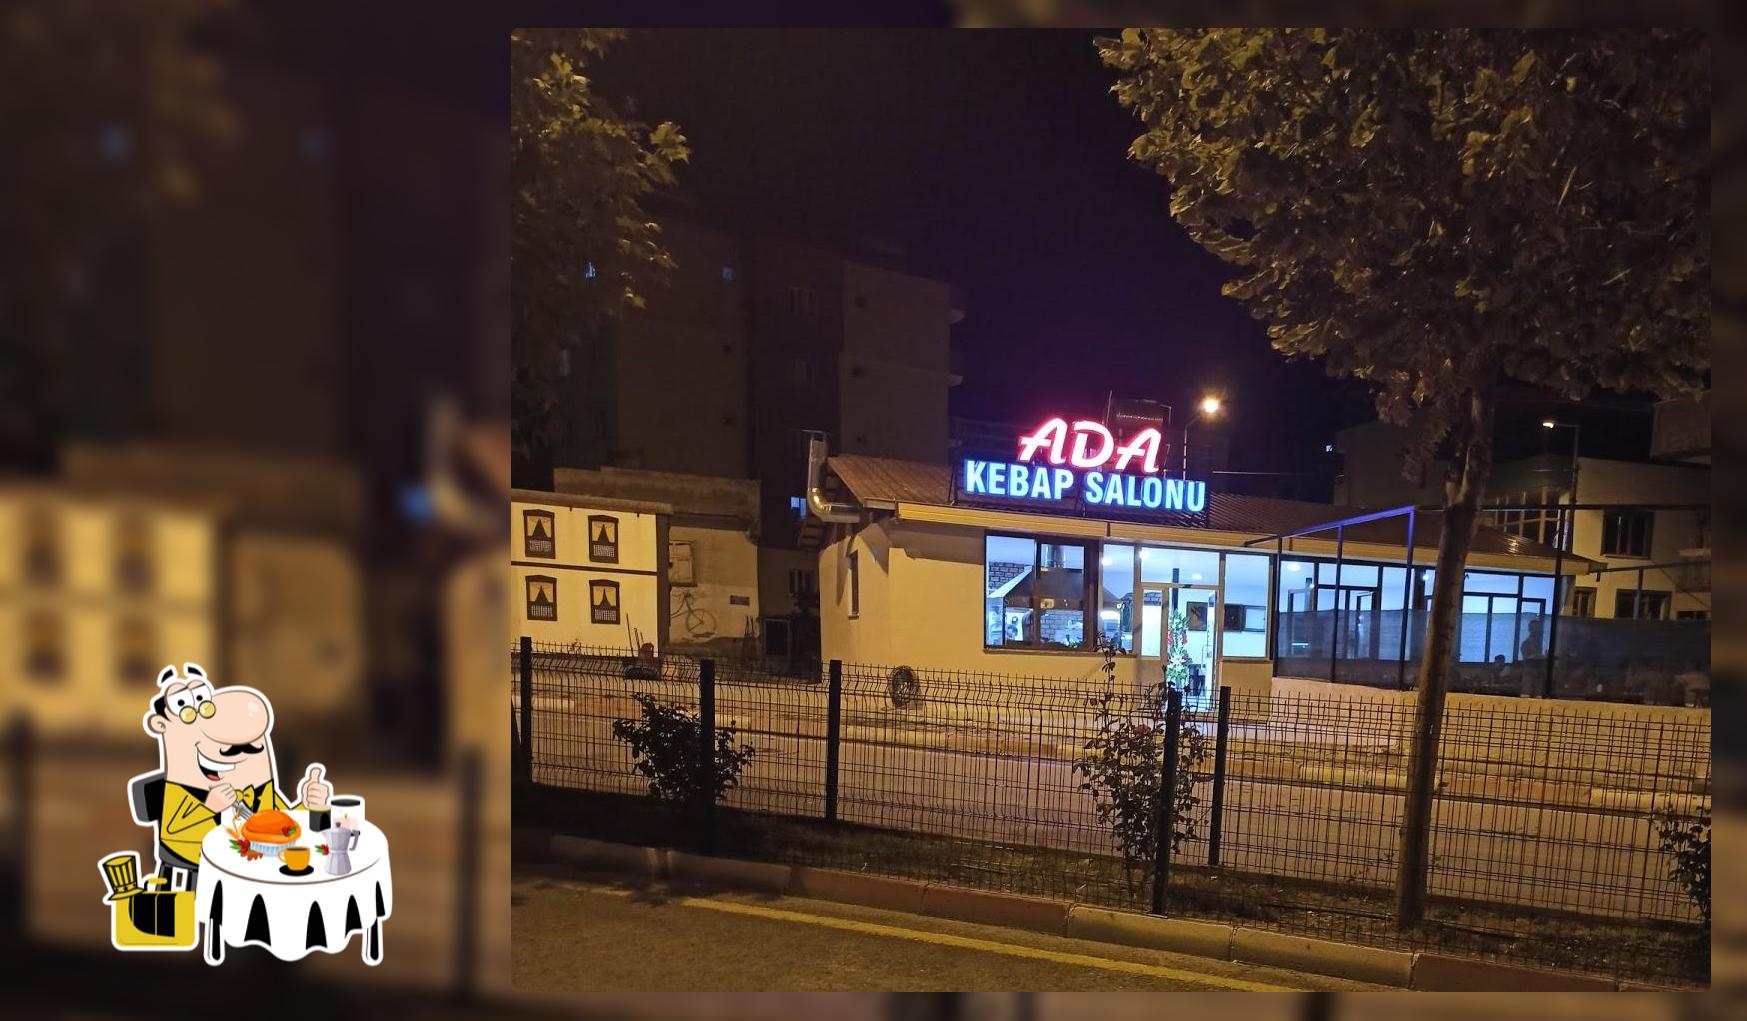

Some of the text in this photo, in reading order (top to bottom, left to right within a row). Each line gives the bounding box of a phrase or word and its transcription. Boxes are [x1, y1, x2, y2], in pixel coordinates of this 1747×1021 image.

[1018, 418, 1162, 473] ADA
[965, 460, 1206, 512] KEBAP SALONU
